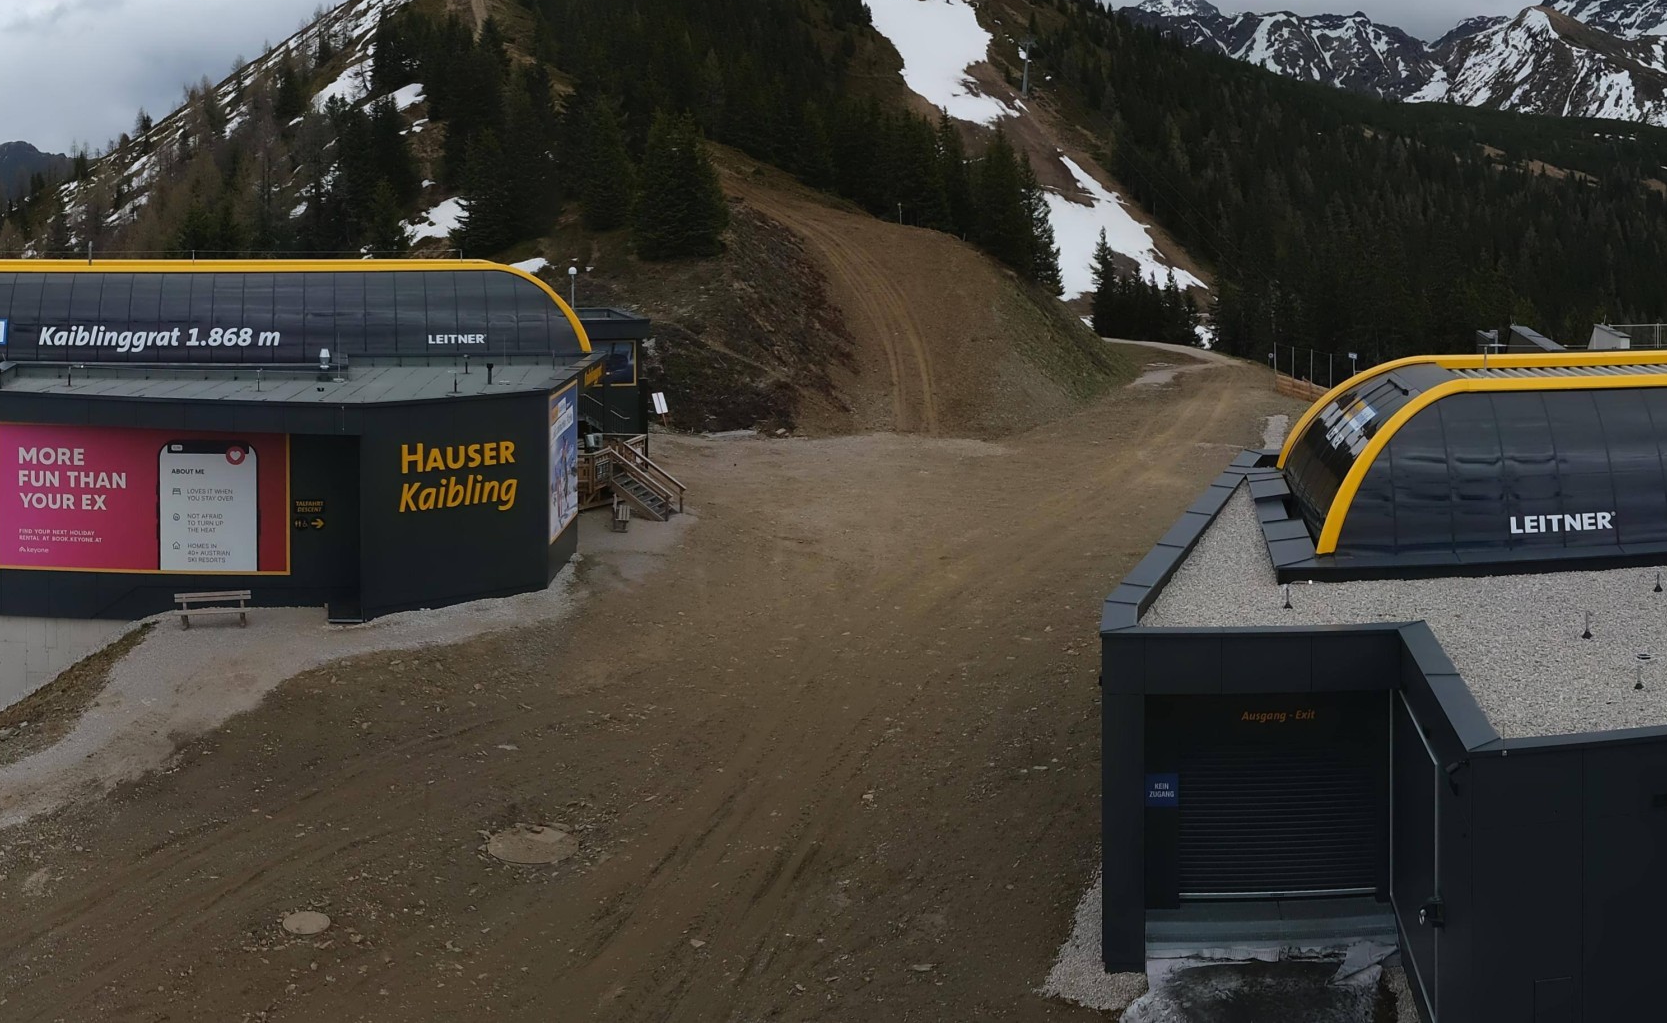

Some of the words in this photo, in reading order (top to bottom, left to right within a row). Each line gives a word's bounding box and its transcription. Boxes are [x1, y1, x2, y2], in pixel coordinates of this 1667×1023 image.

[38, 326, 181, 352] Kaiblinggrat
[186, 327, 253, 346] 1.868
[258, 330, 281, 346] m
[18, 447, 85, 466] MORE
[401, 441, 515, 474] HAUSER
[18, 470, 60, 487] FUN
[66, 471, 127, 489] THAN
[19, 493, 75, 509] YOUR
[81, 494, 107, 510] EX
[399, 474, 518, 513] Kaibling
[1241, 711, 1287, 723] Ausgang
[1295, 708, 1316, 720] Exit
[1149, 790, 1175, 798] ZUGANG
[1154, 782, 1169, 790] KEIN
